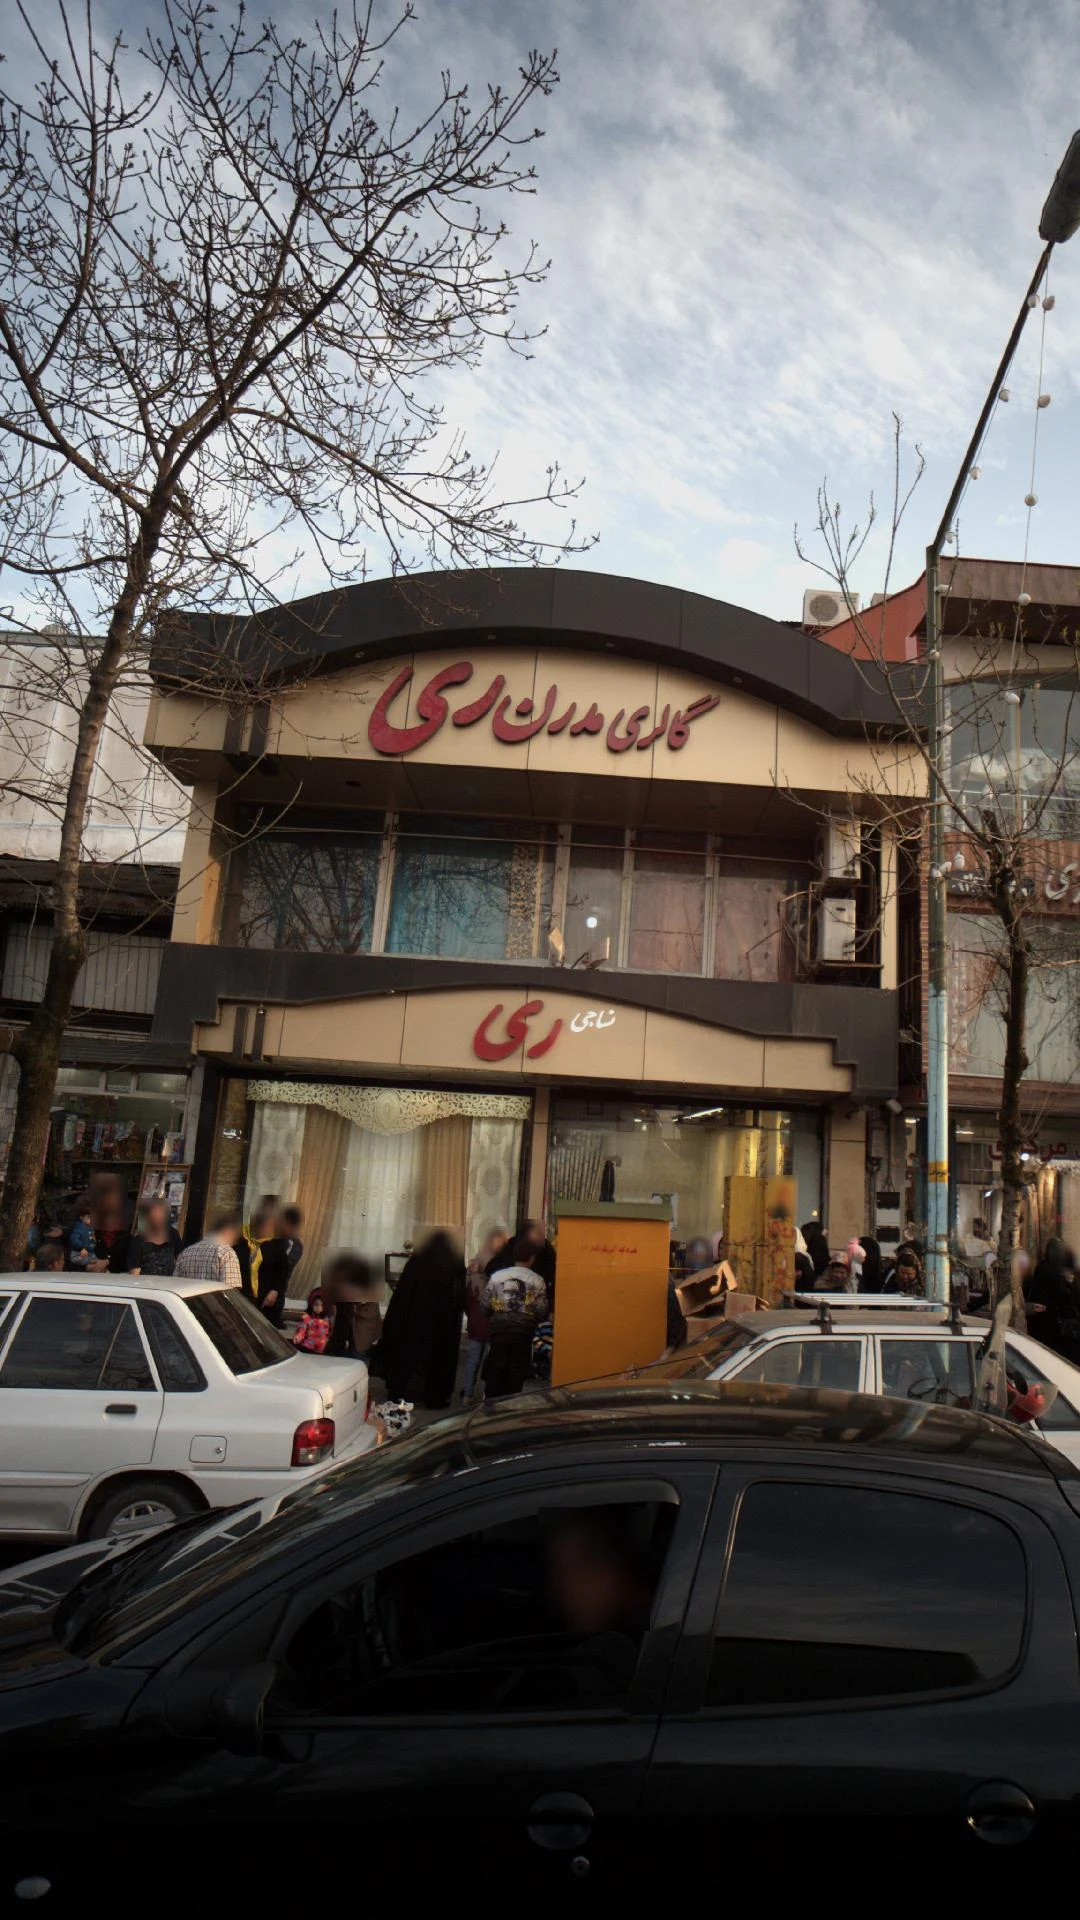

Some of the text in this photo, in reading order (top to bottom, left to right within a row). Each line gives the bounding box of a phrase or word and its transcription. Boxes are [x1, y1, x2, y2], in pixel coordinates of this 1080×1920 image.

[367, 660, 721, 756] گالری مدرن ری
[473, 999, 563, 1062] ری
